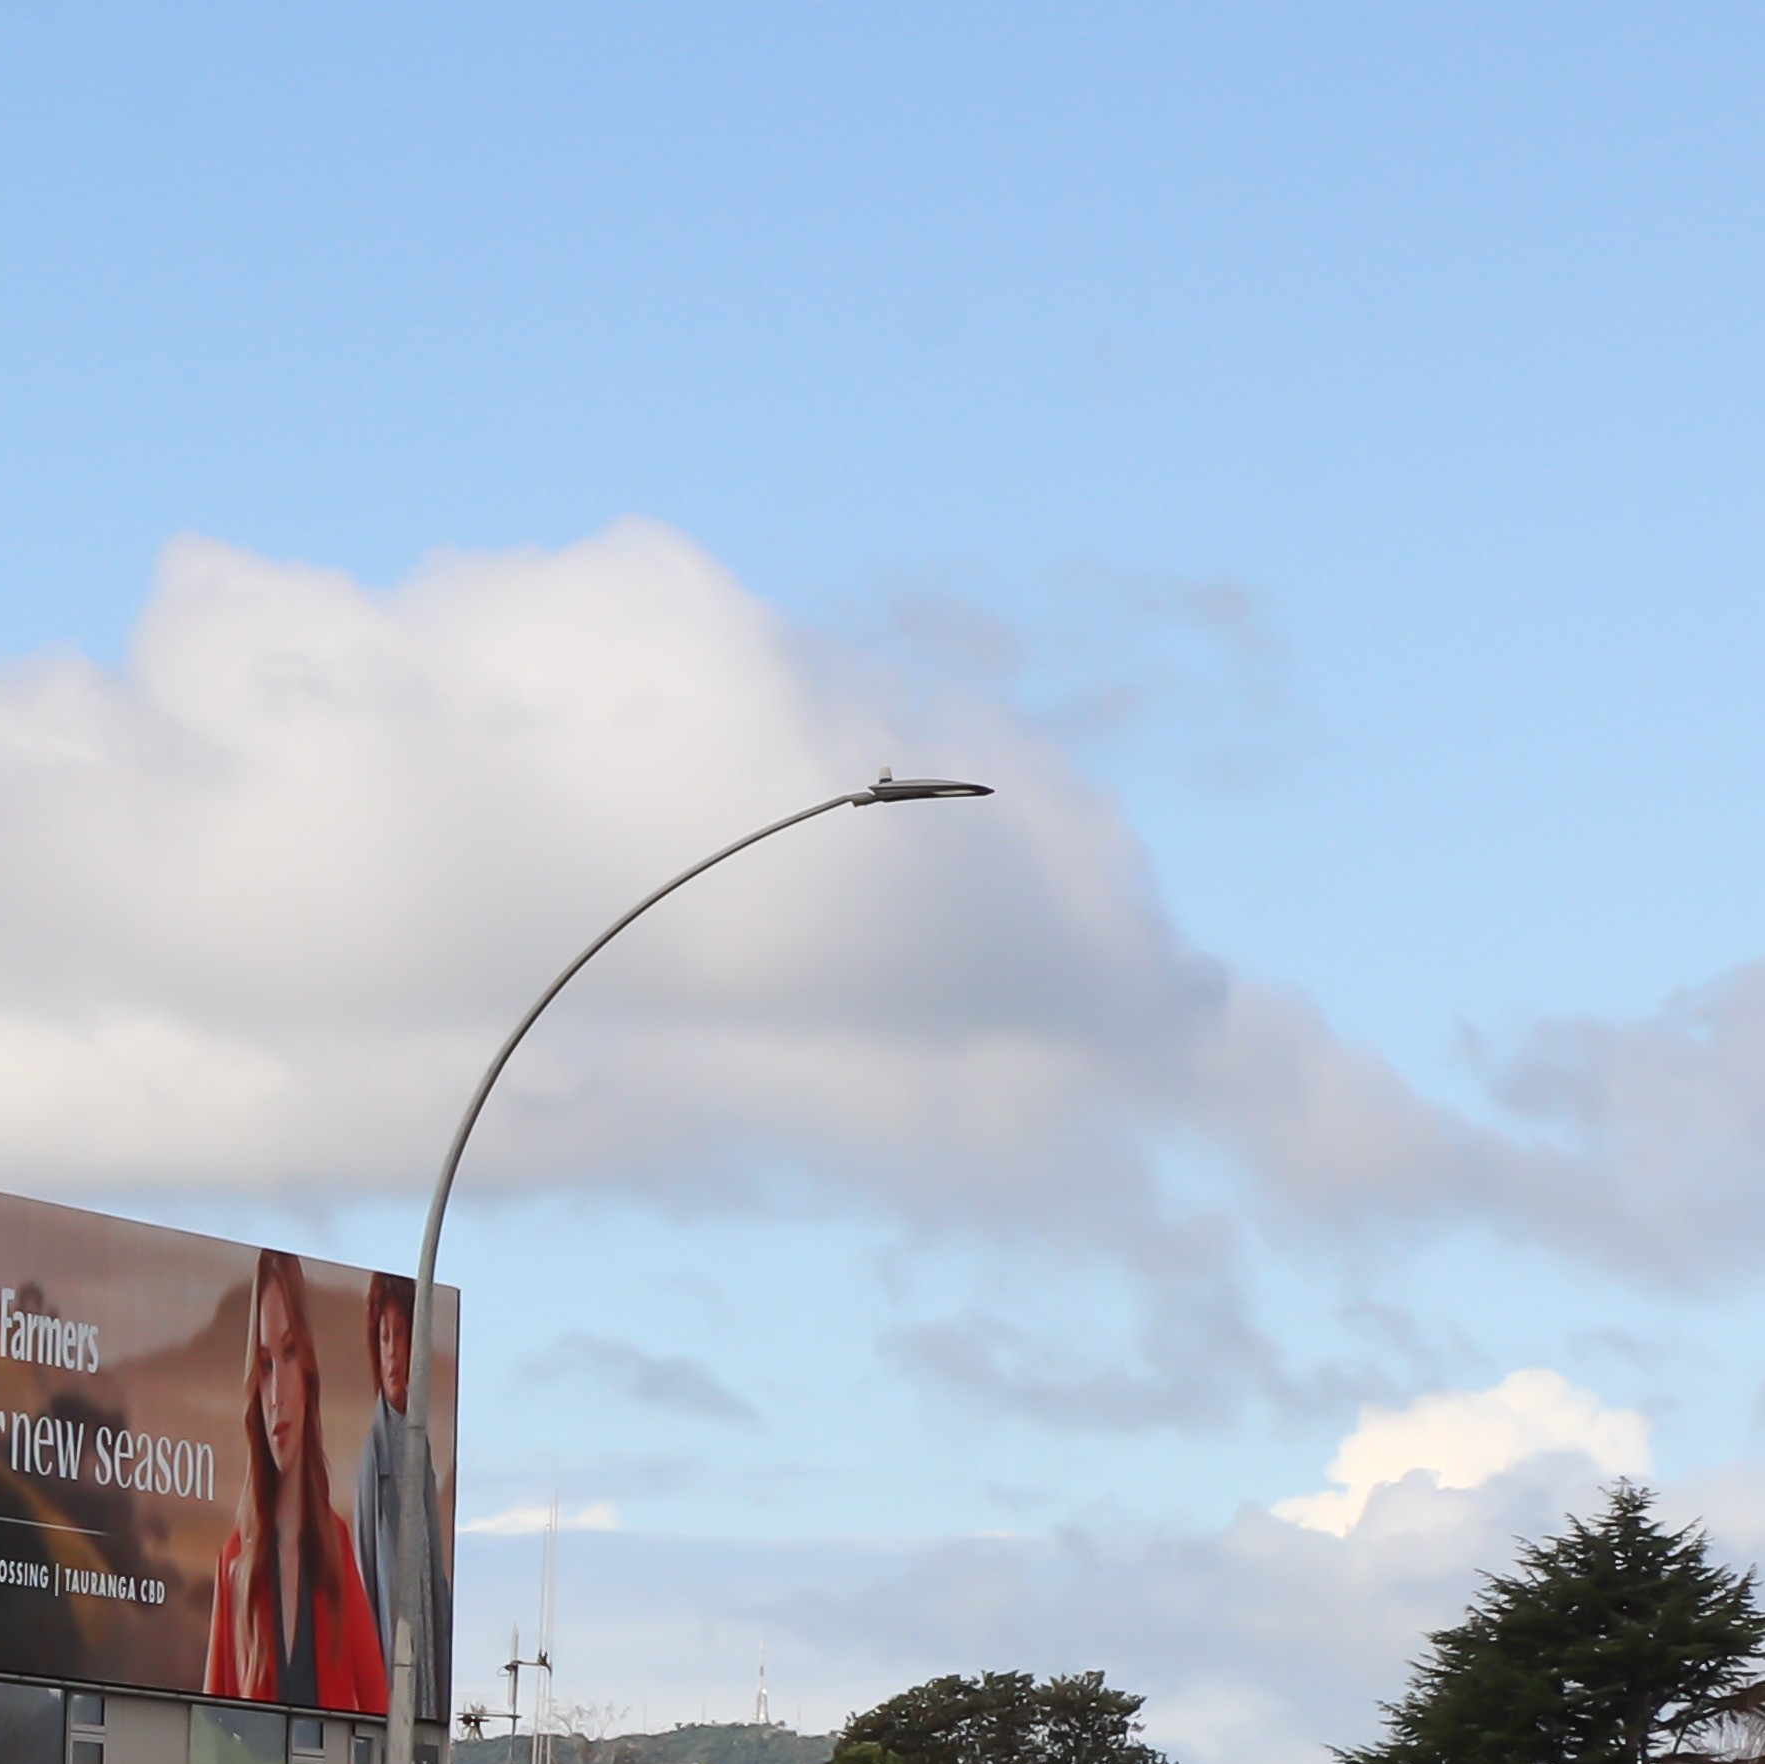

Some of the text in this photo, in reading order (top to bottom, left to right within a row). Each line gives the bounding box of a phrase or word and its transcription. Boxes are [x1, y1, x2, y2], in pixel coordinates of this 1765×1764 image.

[0, 1286, 101, 1375] Farmers
[11, 1410, 85, 1482] new
[94, 1425, 216, 1504] season
[63, 1567, 137, 1601] TAURANGA
[139, 1579, 167, 1605] CBD
